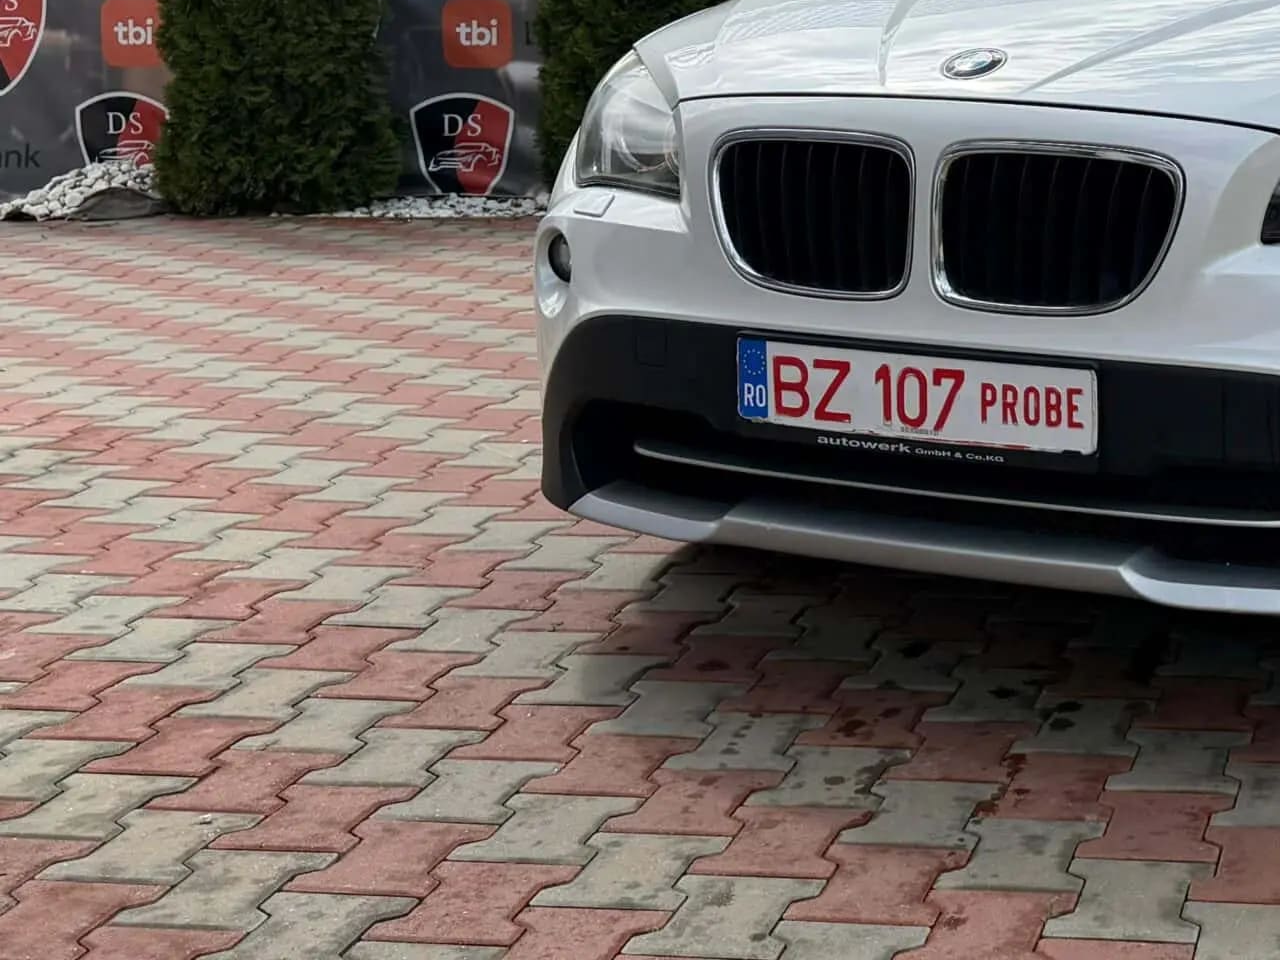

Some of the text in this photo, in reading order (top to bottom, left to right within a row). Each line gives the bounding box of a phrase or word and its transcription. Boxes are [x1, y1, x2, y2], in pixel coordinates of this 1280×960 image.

[113, 18, 153, 46] tbi
[455, 19, 499, 47] tbi
[106, 112, 143, 135] DS
[442, 113, 482, 137] DS
[743, 382, 767, 408] RO
[772, 355, 1084, 432] BZ 107 PROBE
[816, 434, 911, 454] autowerk
[915, 447, 951, 458] GmbH
